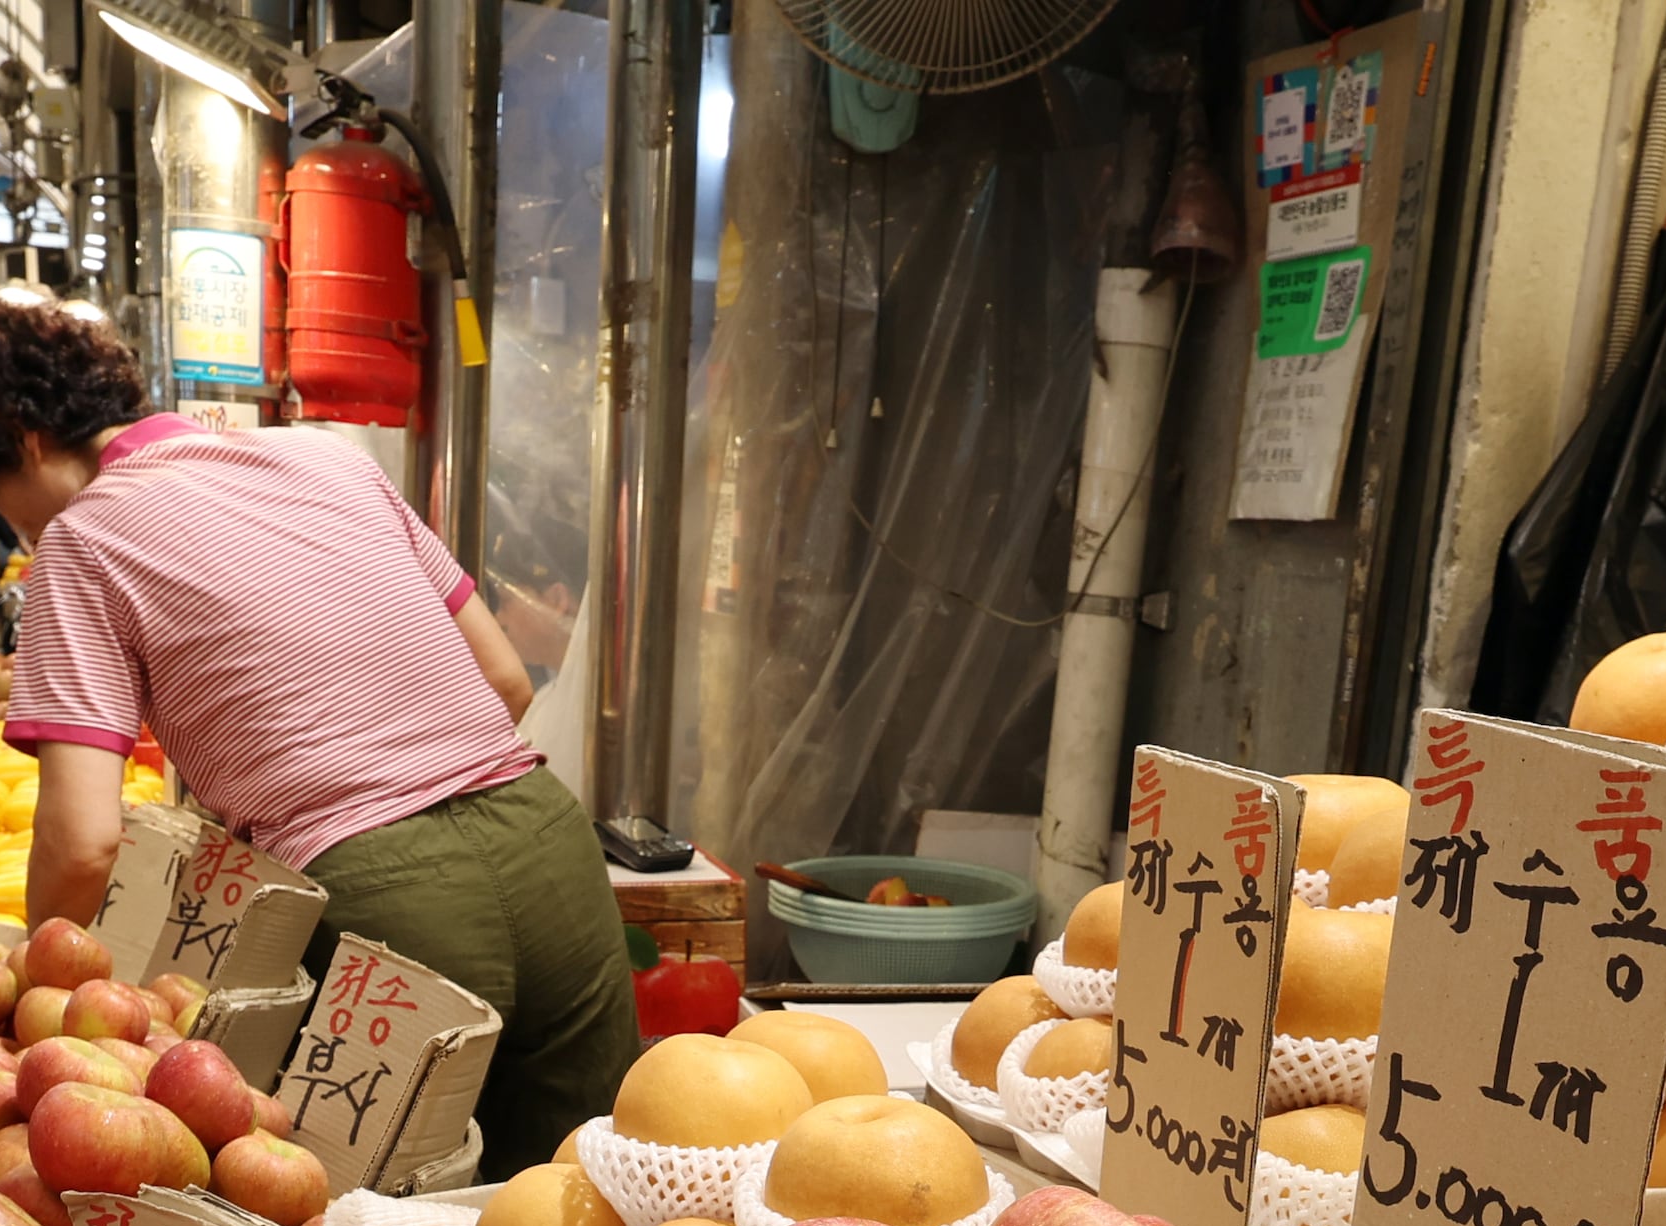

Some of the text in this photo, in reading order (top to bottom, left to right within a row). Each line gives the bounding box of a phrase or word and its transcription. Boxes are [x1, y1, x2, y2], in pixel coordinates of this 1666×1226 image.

[178, 303, 248, 328] 화재공제
[179, 277, 248, 304] 전통시장
[195, 837, 257, 906] 청송
[1130, 840, 1274, 957] 제수용
[170, 893, 237, 978] 부사
[330, 956, 417, 1046] 청송
[293, 1033, 392, 1146] 부사
[1108, 1020, 1256, 1209] 5.000원
